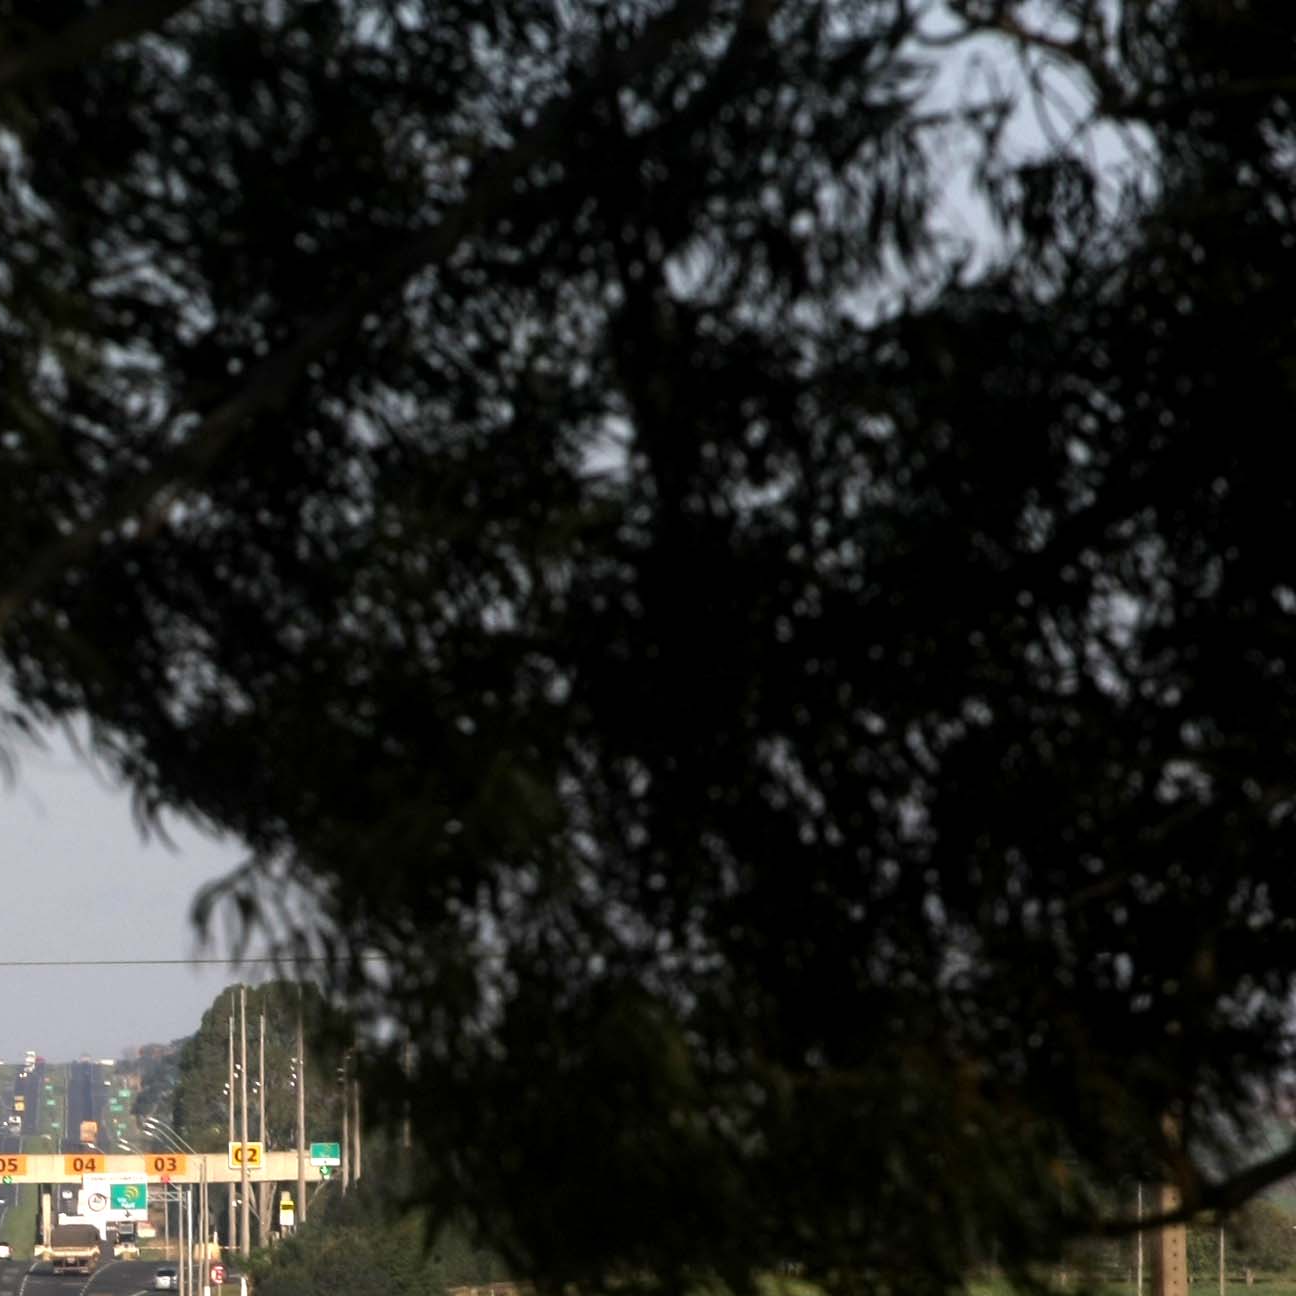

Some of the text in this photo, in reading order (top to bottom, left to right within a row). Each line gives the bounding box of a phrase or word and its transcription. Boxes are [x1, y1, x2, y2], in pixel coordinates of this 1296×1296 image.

[234, 1147, 257, 1162] 02
[72, 1157, 96, 1172] 04
[154, 1157, 177, 1172] 03
